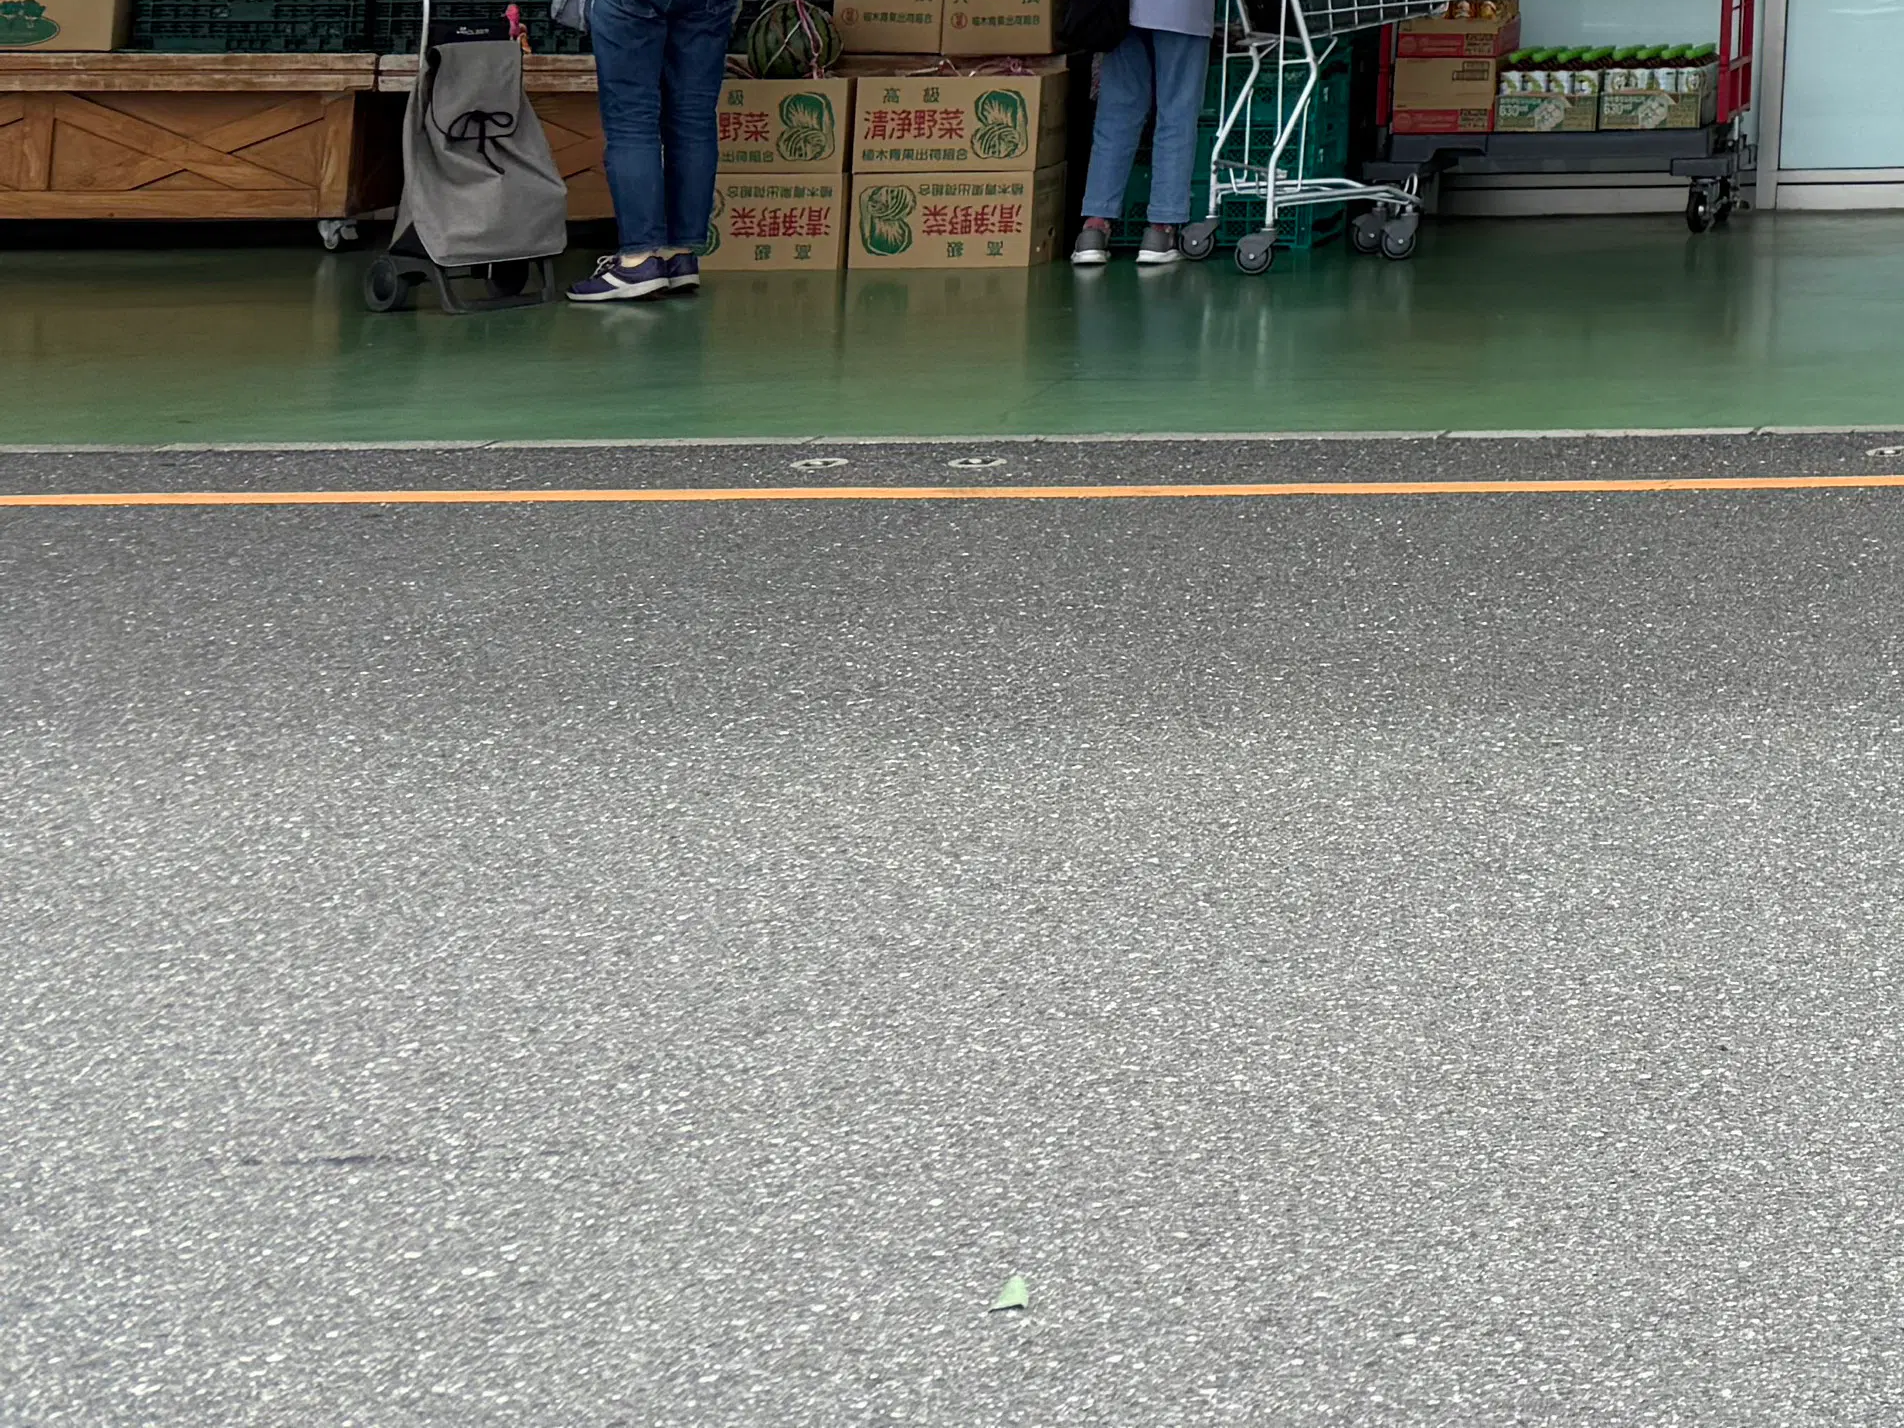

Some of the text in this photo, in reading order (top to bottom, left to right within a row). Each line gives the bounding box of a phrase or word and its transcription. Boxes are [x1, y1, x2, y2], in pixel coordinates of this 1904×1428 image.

[883, 87, 940, 104] 高級
[718, 111, 770, 142] 野菜
[722, 150, 774, 164] 出荷組合
